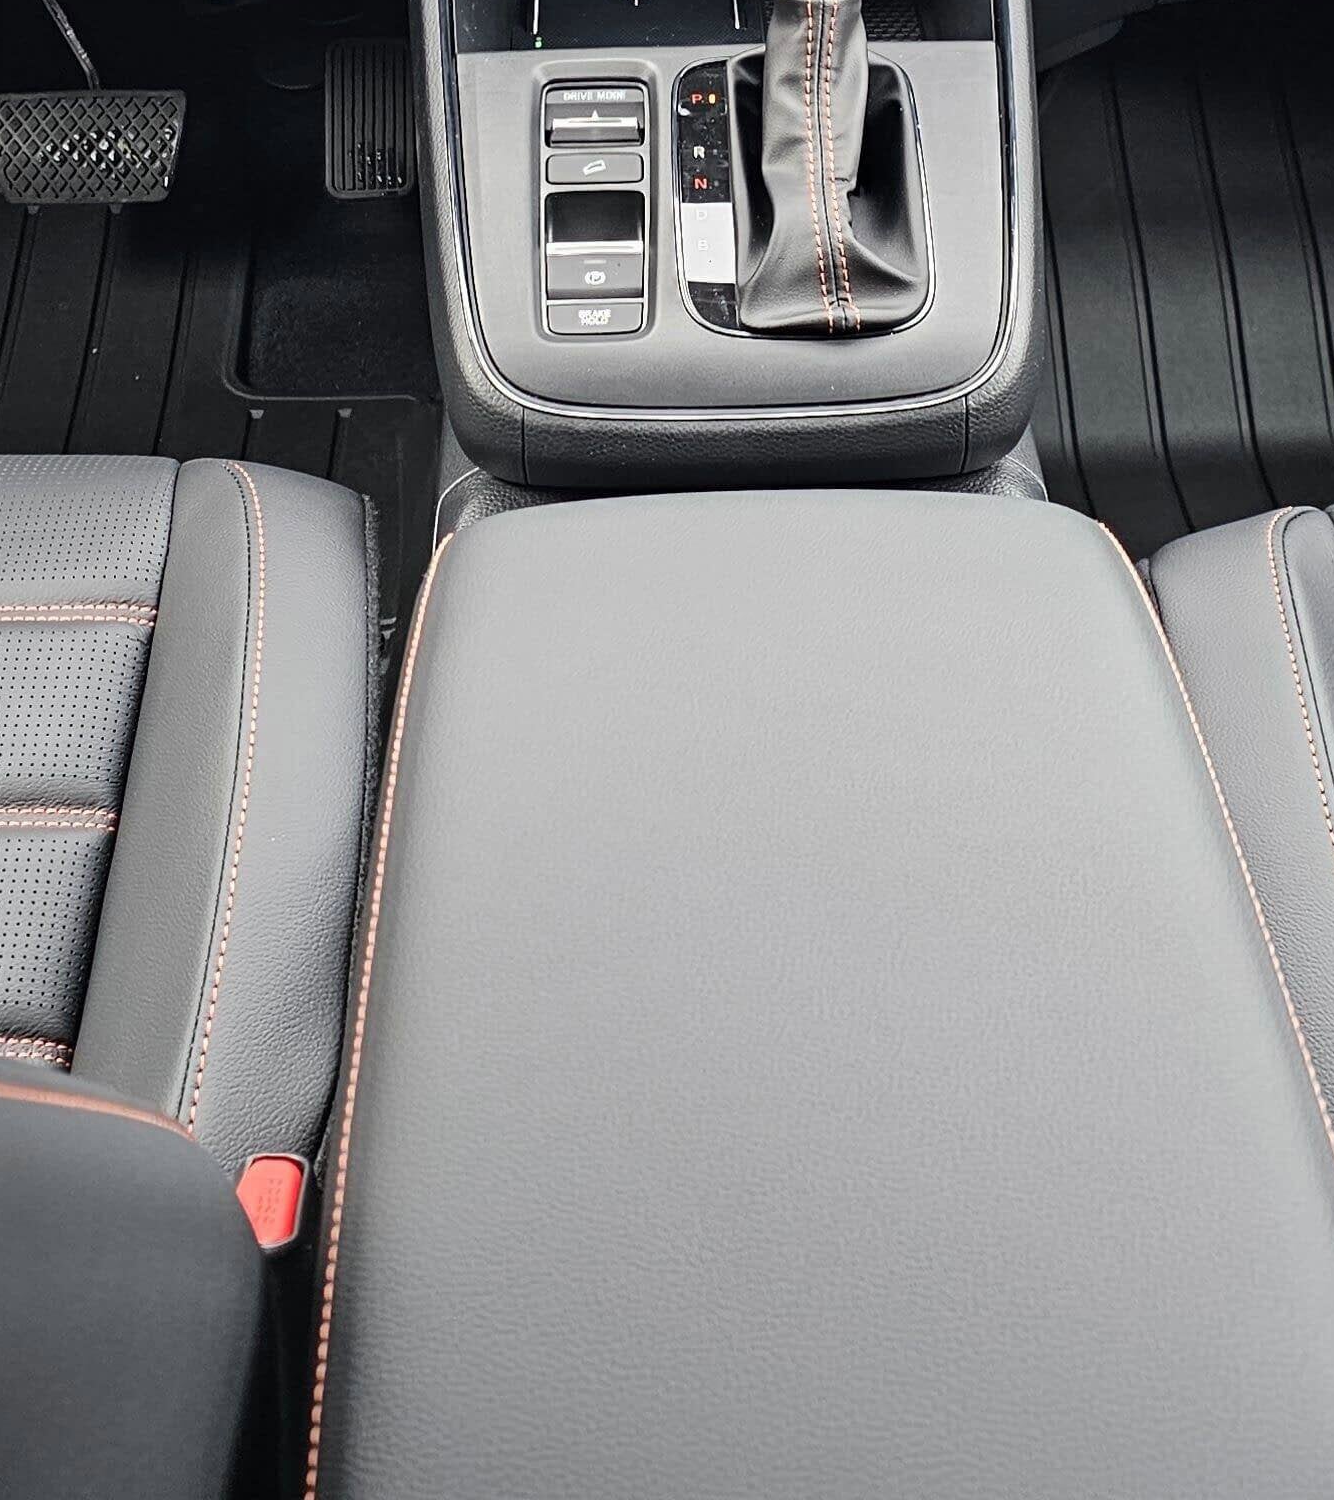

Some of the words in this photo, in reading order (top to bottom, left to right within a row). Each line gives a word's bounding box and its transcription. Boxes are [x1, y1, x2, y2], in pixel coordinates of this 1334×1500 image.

[691, 93, 703, 104] P
[692, 146, 705, 159] R
[694, 176, 708, 190] N
[696, 210, 708, 221] D
